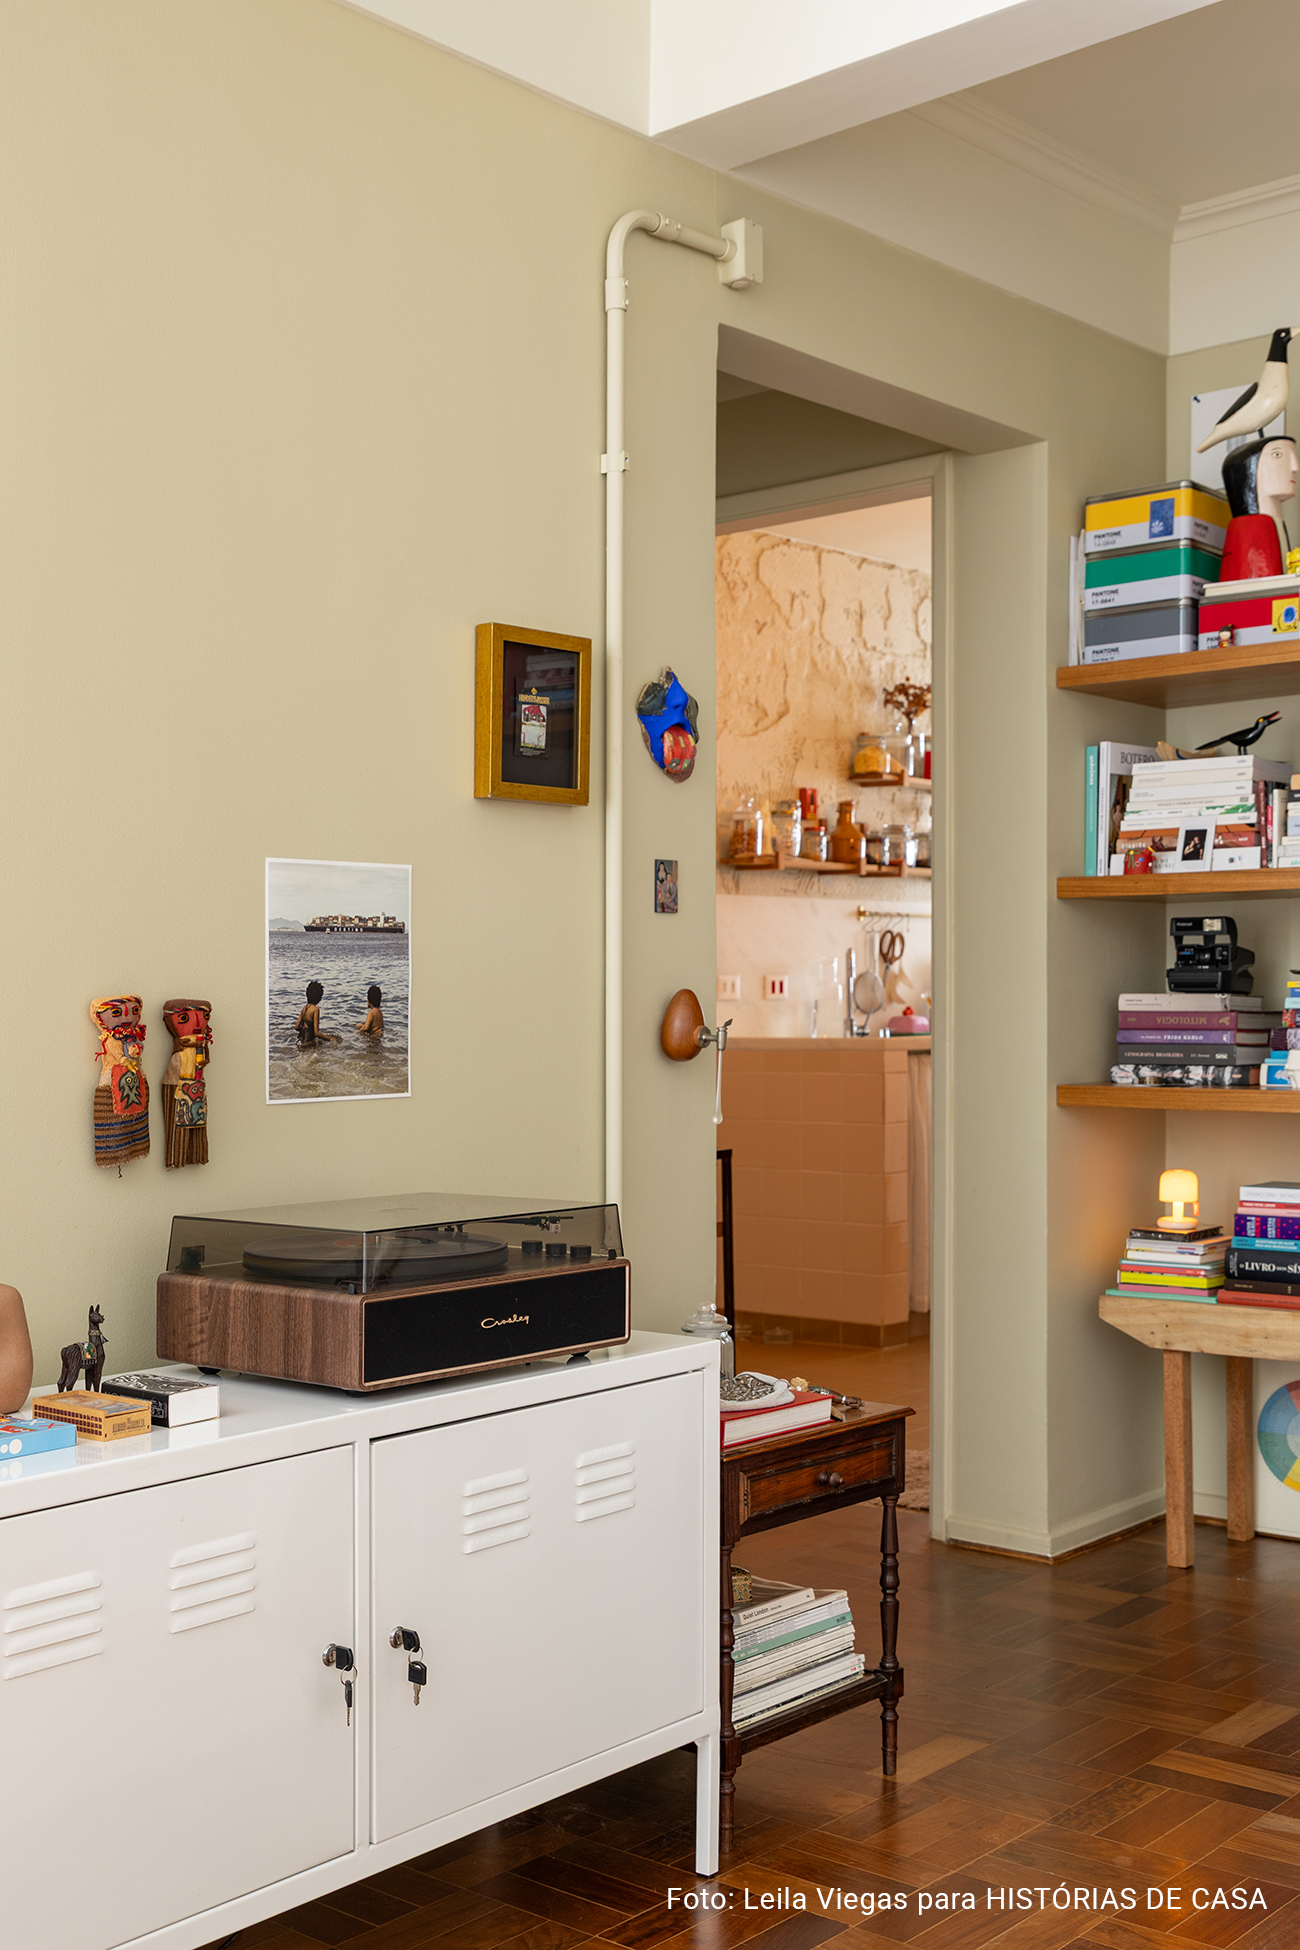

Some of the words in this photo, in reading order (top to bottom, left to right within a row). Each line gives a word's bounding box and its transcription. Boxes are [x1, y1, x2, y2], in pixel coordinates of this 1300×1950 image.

[1094, 530, 1121, 539] PANTONE
[1092, 588, 1119, 597] PANTONE
[1092, 646, 1119, 655] PANTONE
[1120, 751, 1155, 765] BOTERO
[1156, 1016, 1207, 1025] MITOLOGIA
[1245, 1261, 1276, 1273] LIVRO
[481, 1313, 529, 1328] Crosley
[743, 1612, 755, 1620] Quiet
[754, 1607, 769, 1617] London
